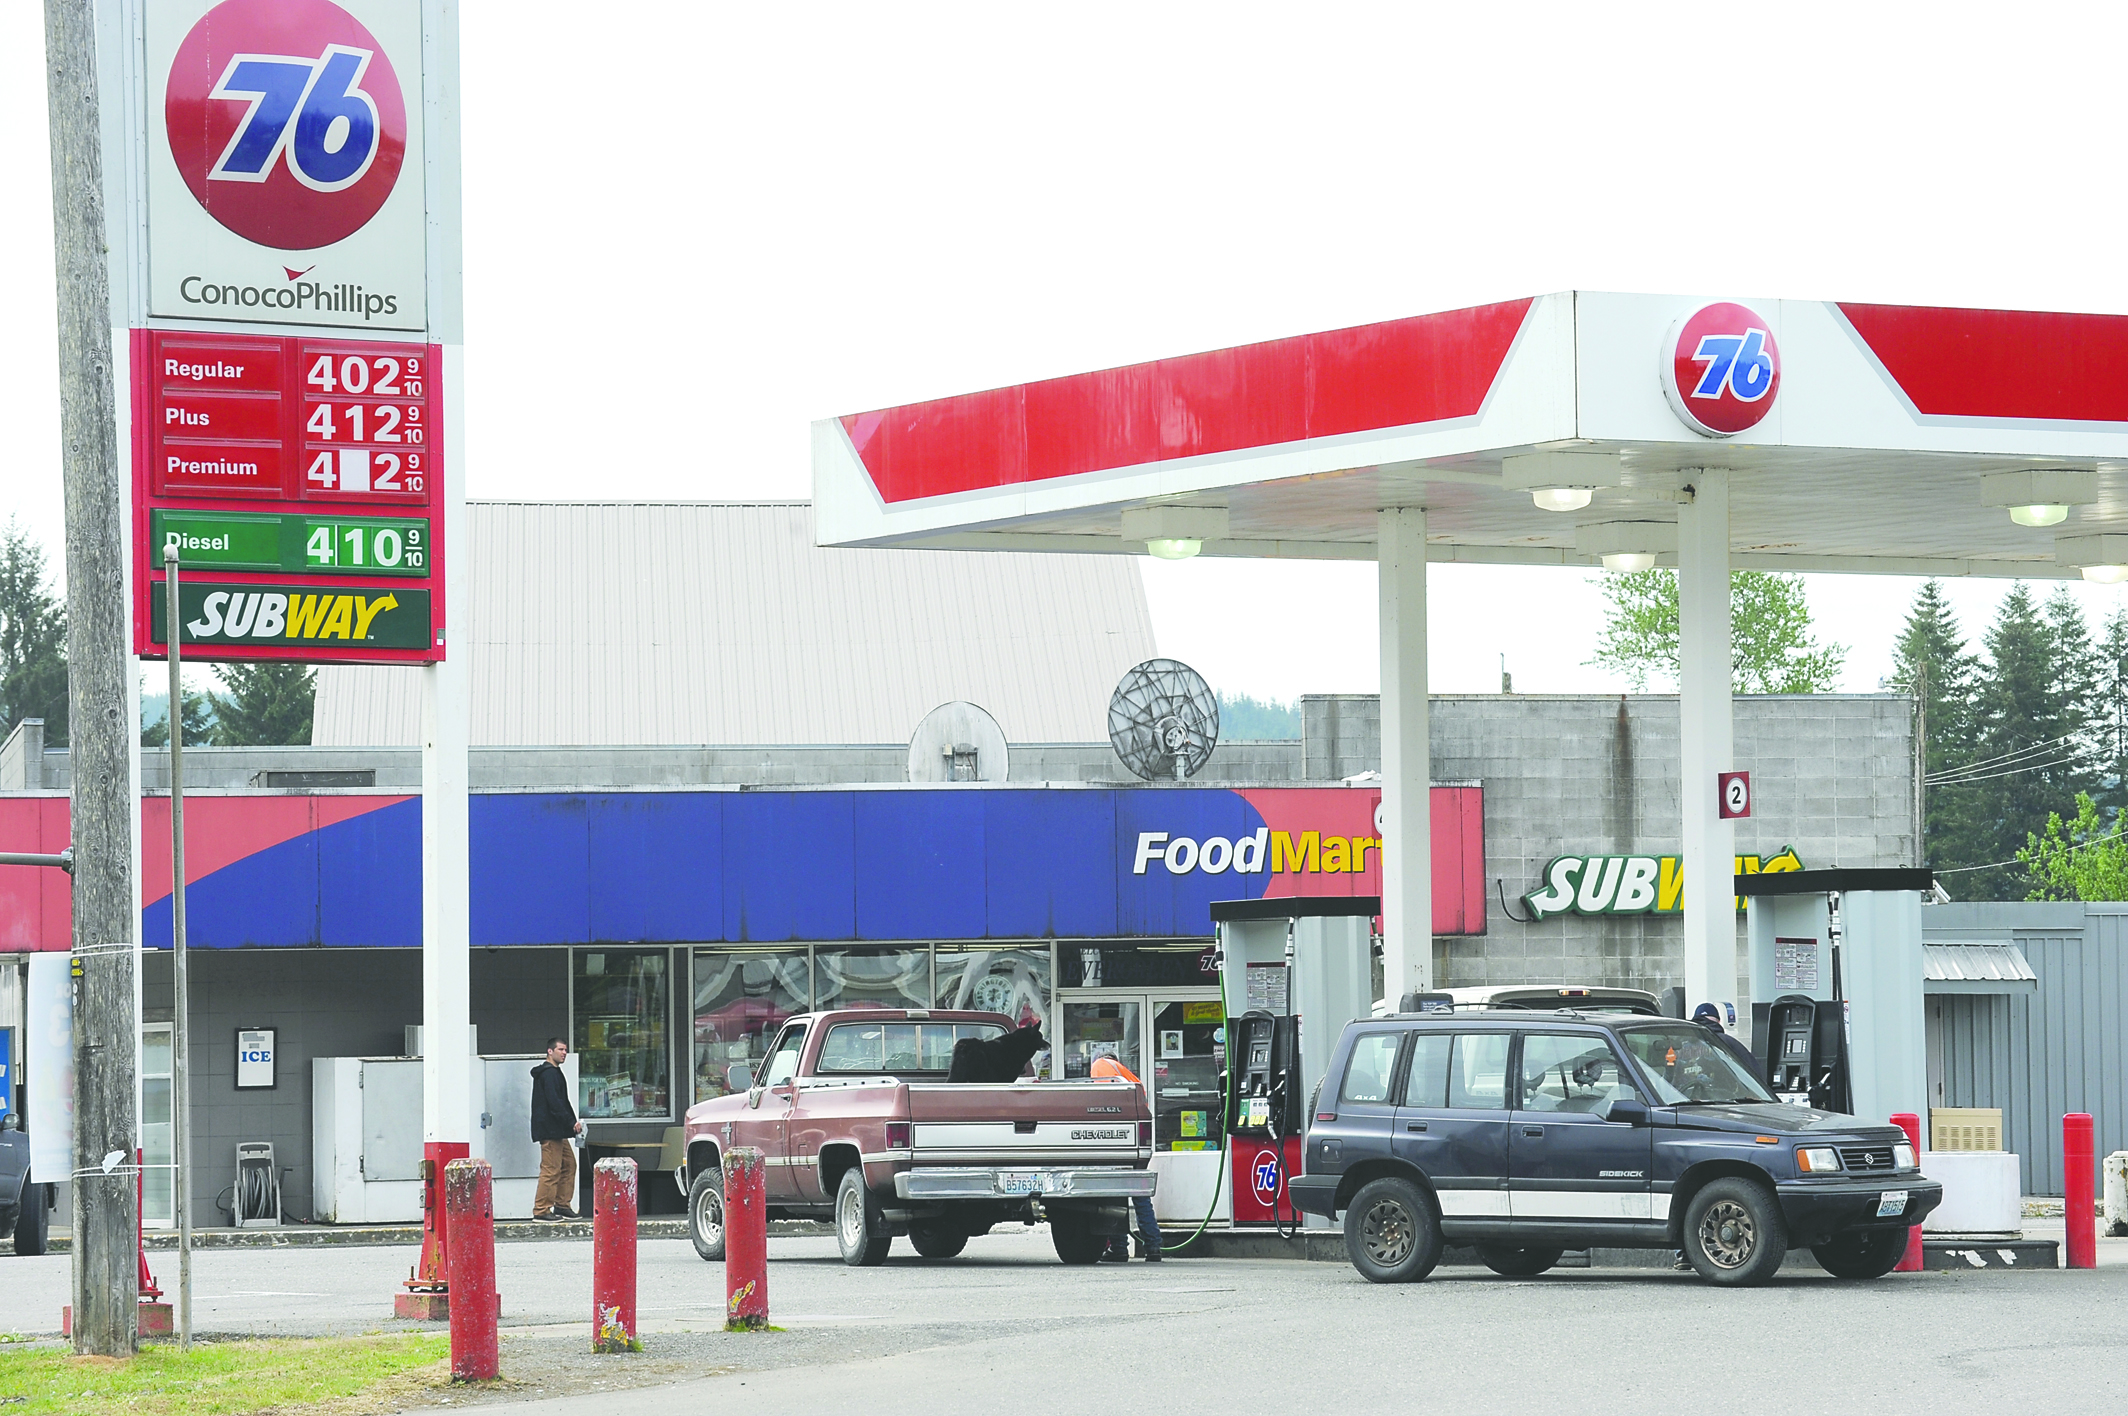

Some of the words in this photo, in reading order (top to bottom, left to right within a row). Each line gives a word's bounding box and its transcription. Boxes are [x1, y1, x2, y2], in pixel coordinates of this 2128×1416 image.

[206, 43, 380, 192] 76
[180, 276, 398, 320] ConocoPhillips
[165, 358, 244, 379] Regular
[307, 355, 401, 395] 402
[1690, 327, 1774, 403] 76
[165, 408, 210, 426] Plus
[306, 403, 401, 443] 412
[167, 457, 258, 476] Premium
[165, 531, 229, 551] Diesel
[306, 527, 402, 567] 410
[187, 591, 399, 640] SUBWAY
[1732, 786, 1741, 805] 2
[241, 1050, 272, 1063] ICE
[1071, 1129, 1130, 1140] CHEVROLET
[1006, 1179, 1044, 1191] B57632H
[1256, 1161, 1278, 1191] 76
[1598, 1169, 1644, 1178] SIDEKICK
